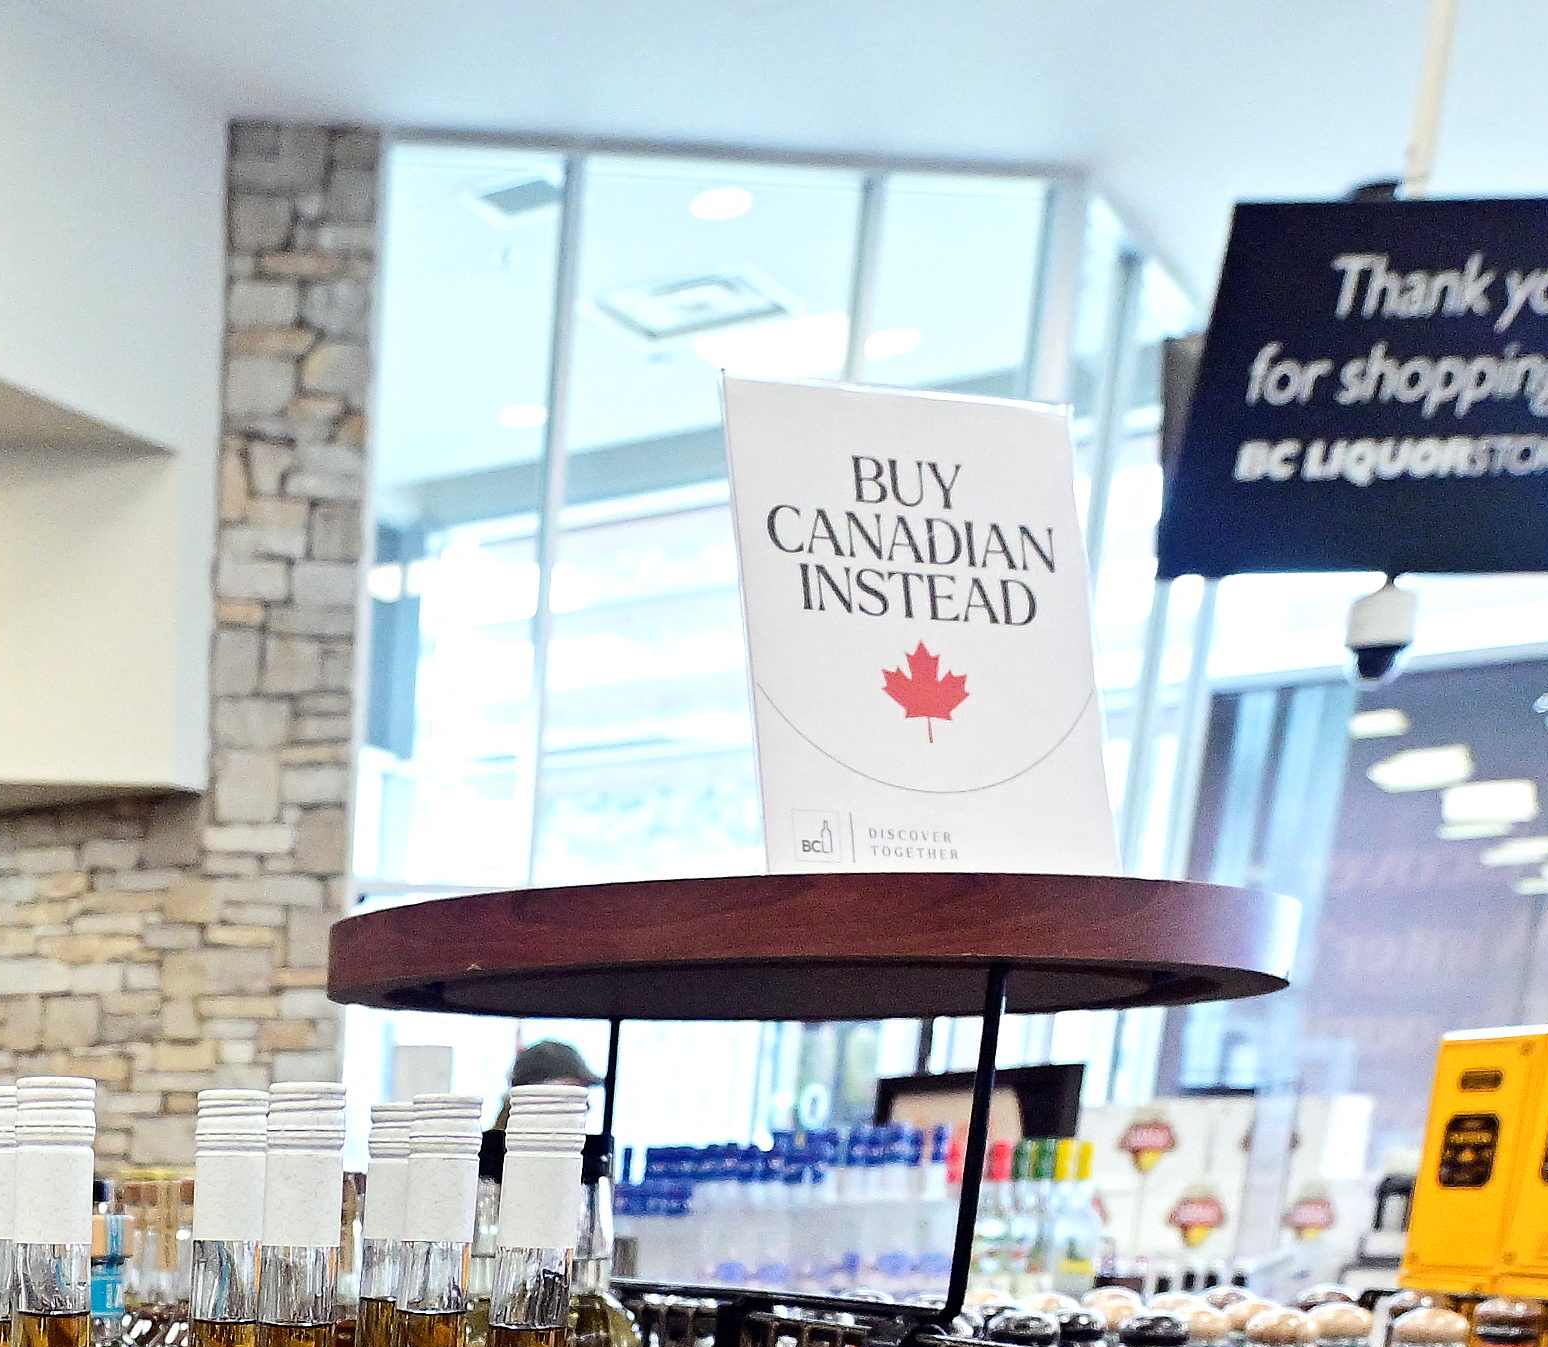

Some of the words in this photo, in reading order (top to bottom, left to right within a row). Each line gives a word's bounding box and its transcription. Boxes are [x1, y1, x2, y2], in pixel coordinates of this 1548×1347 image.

[1331, 252, 1496, 320] Thank
[1244, 340, 1332, 406] for
[851, 455, 962, 509] BUY
[1233, 439, 1299, 483] BC
[766, 504, 1056, 573] CANADIAN
[799, 562, 1037, 627] INSTEAD
[868, 827, 952, 843] DISCOVER
[870, 845, 959, 860] TOGETHER
